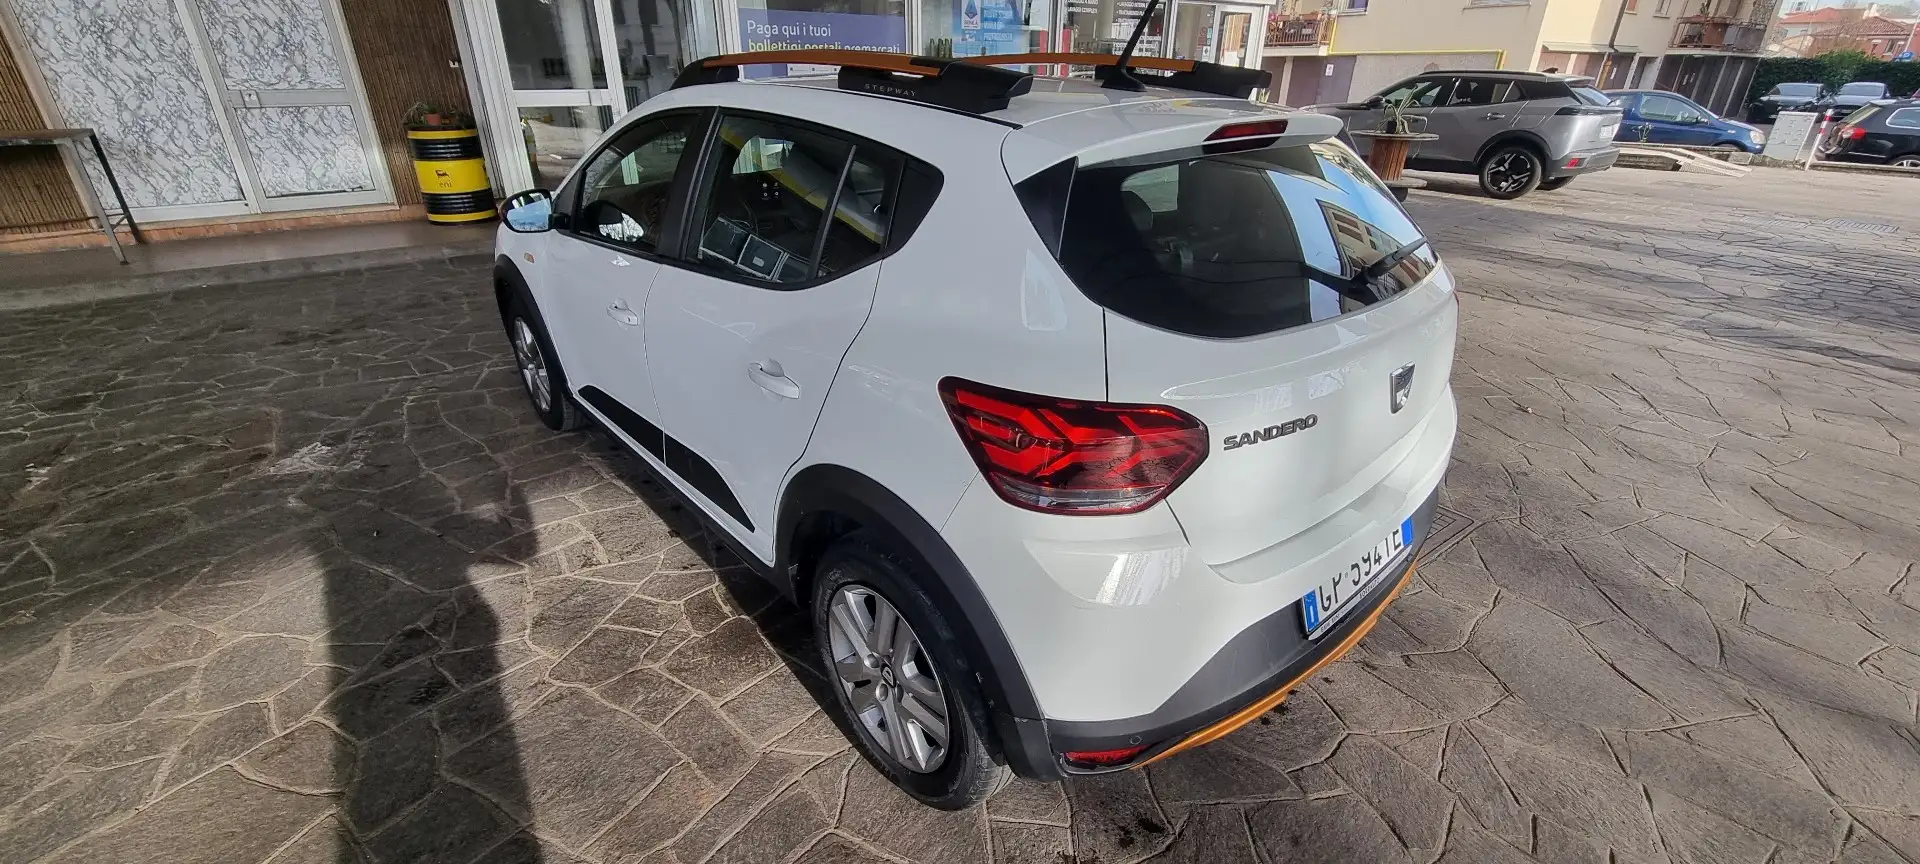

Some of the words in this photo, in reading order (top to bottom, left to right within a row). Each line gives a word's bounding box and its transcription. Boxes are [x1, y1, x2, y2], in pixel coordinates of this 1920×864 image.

[747, 20, 779, 37] Paga
[782, 22, 800, 38] qui
[803, 22, 806, 36] i
[809, 23, 831, 37] tuoi
[864, 83, 916, 96] STEPWAY
[439, 180, 452, 188] eni
[1223, 413, 1318, 451] SANDERO
